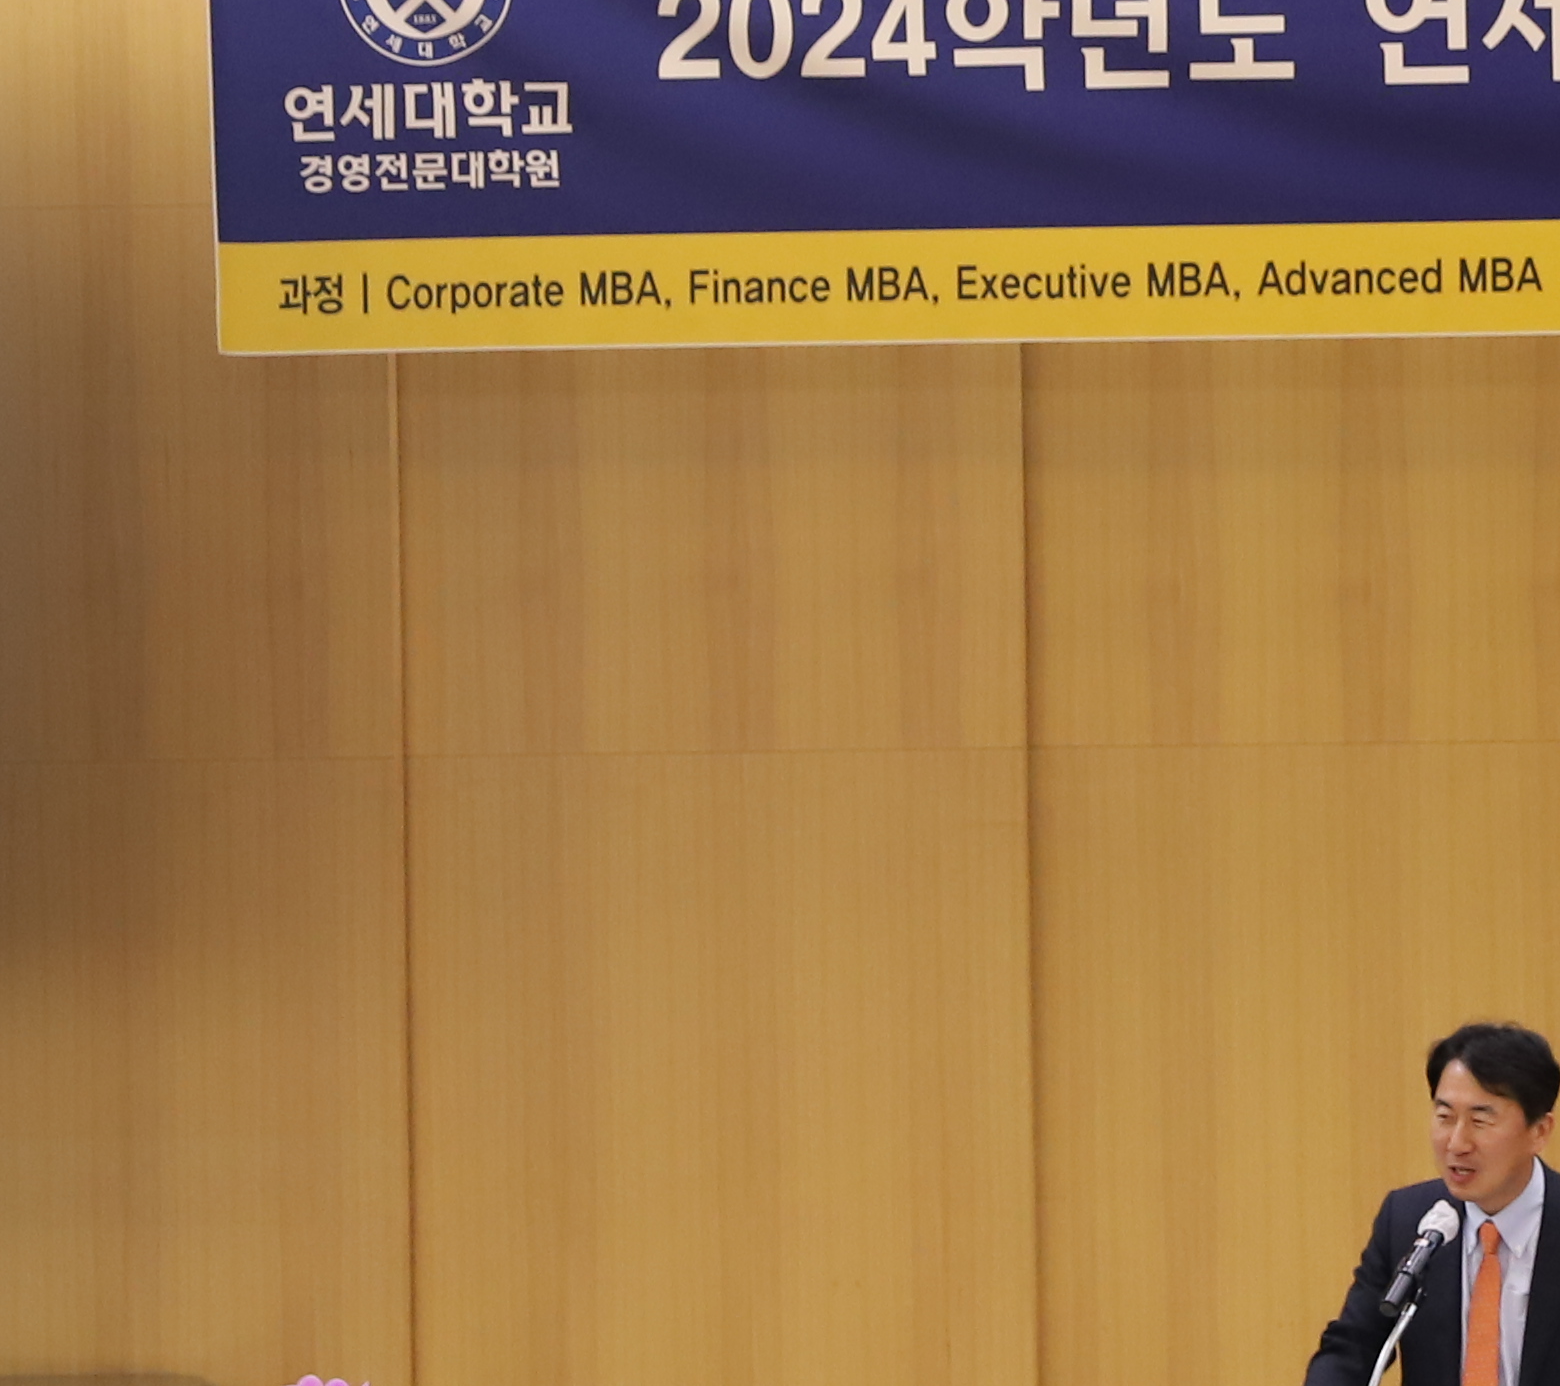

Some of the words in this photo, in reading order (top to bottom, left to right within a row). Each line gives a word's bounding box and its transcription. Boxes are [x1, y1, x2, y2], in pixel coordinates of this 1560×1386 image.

[284, 78, 573, 143] 연세대학교
[299, 149, 560, 195] 경영전문대학원
[277, 272, 344, 317] 과정
[386, 273, 564, 316] Corporate
[579, 269, 672, 310] MBA,
[688, 268, 831, 305] Finance
[845, 265, 939, 306] MBA,
[956, 262, 1131, 301] Executive
[1146, 260, 1240, 302] MBA,
[1256, 257, 1442, 298] Advanced
[1458, 255, 1544, 293] MBA
